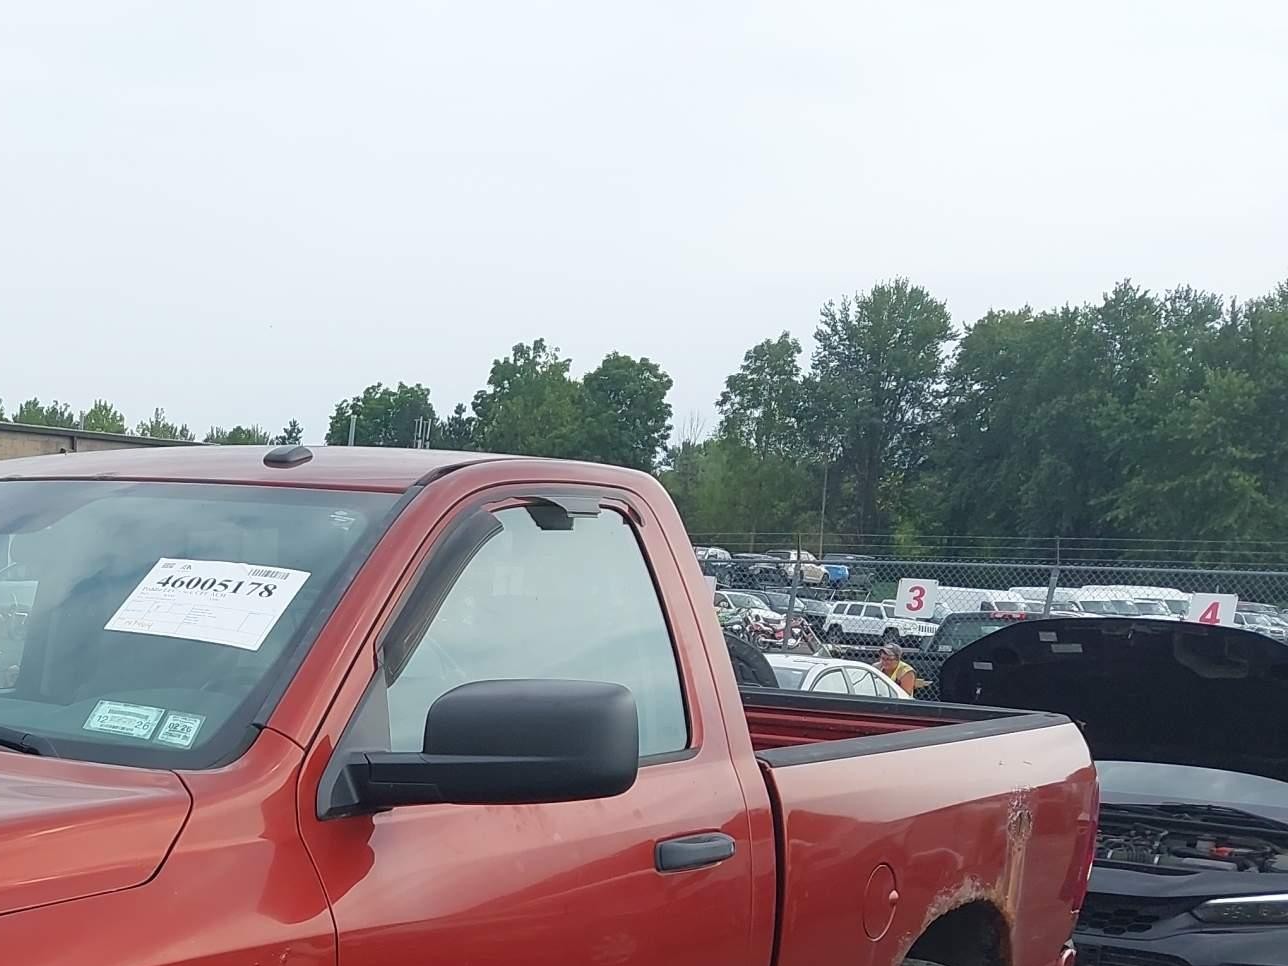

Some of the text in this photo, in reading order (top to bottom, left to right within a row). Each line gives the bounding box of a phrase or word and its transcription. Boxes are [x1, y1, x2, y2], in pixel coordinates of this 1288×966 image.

[156, 575, 277, 598] 46005178
[905, 585, 926, 612] 3
[1198, 601, 1221, 625] 4
